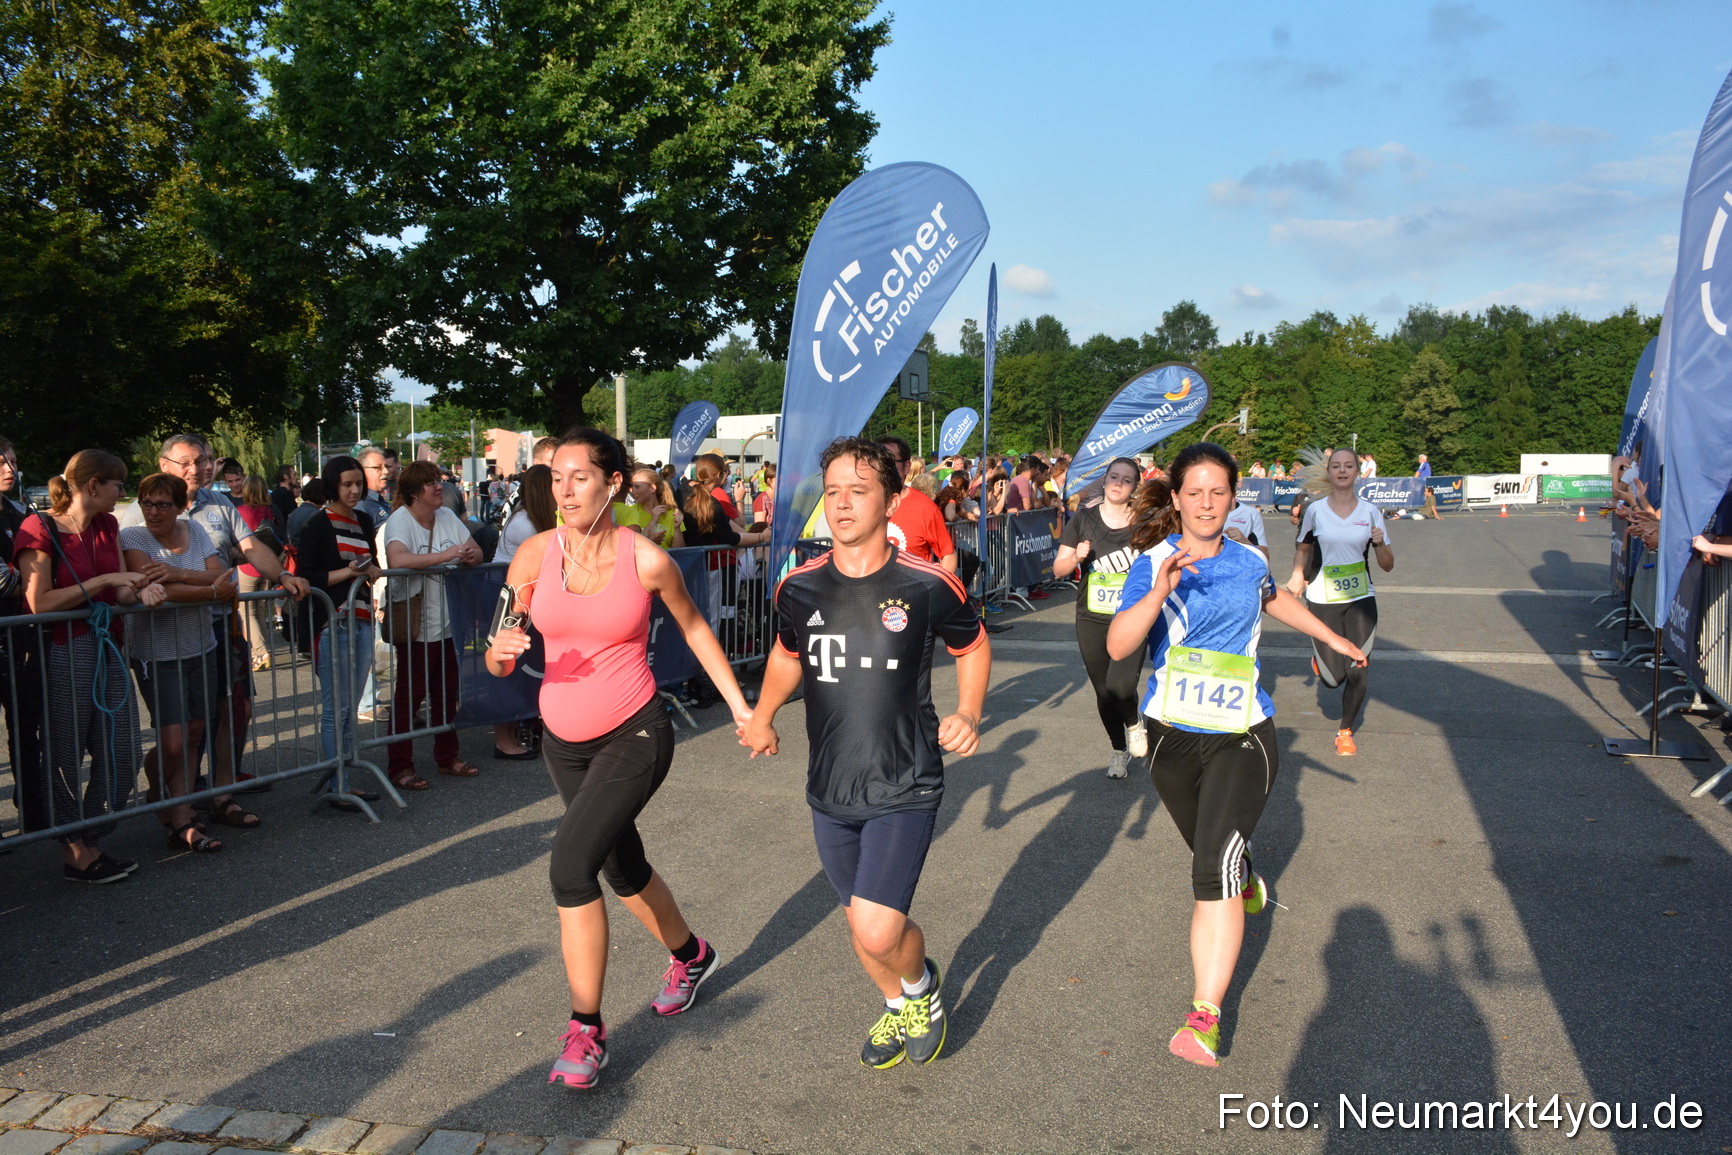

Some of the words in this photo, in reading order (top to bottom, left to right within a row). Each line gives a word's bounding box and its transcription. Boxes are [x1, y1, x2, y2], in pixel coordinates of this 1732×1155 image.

[838, 202, 947, 356] Fischer
[873, 233, 959, 356] AUTOMOBILE
[682, 409, 709, 446] Fischer
[1142, 419, 1164, 434] Druck
[1177, 396, 1204, 415] Medien
[949, 414, 970, 445] Fischer
[1086, 402, 1174, 456] Frischmann
[1235, 489, 1260, 497] scher
[1368, 489, 1411, 499] Fischer
[1547, 480, 1565, 490] AOK
[1572, 480, 1612, 488] GESUNDHEI
[1015, 533, 1052, 556] Frischmann
[1097, 589, 1123, 603] 978
[1333, 577, 1359, 591] 393
[1176, 678, 1244, 710] 1142
